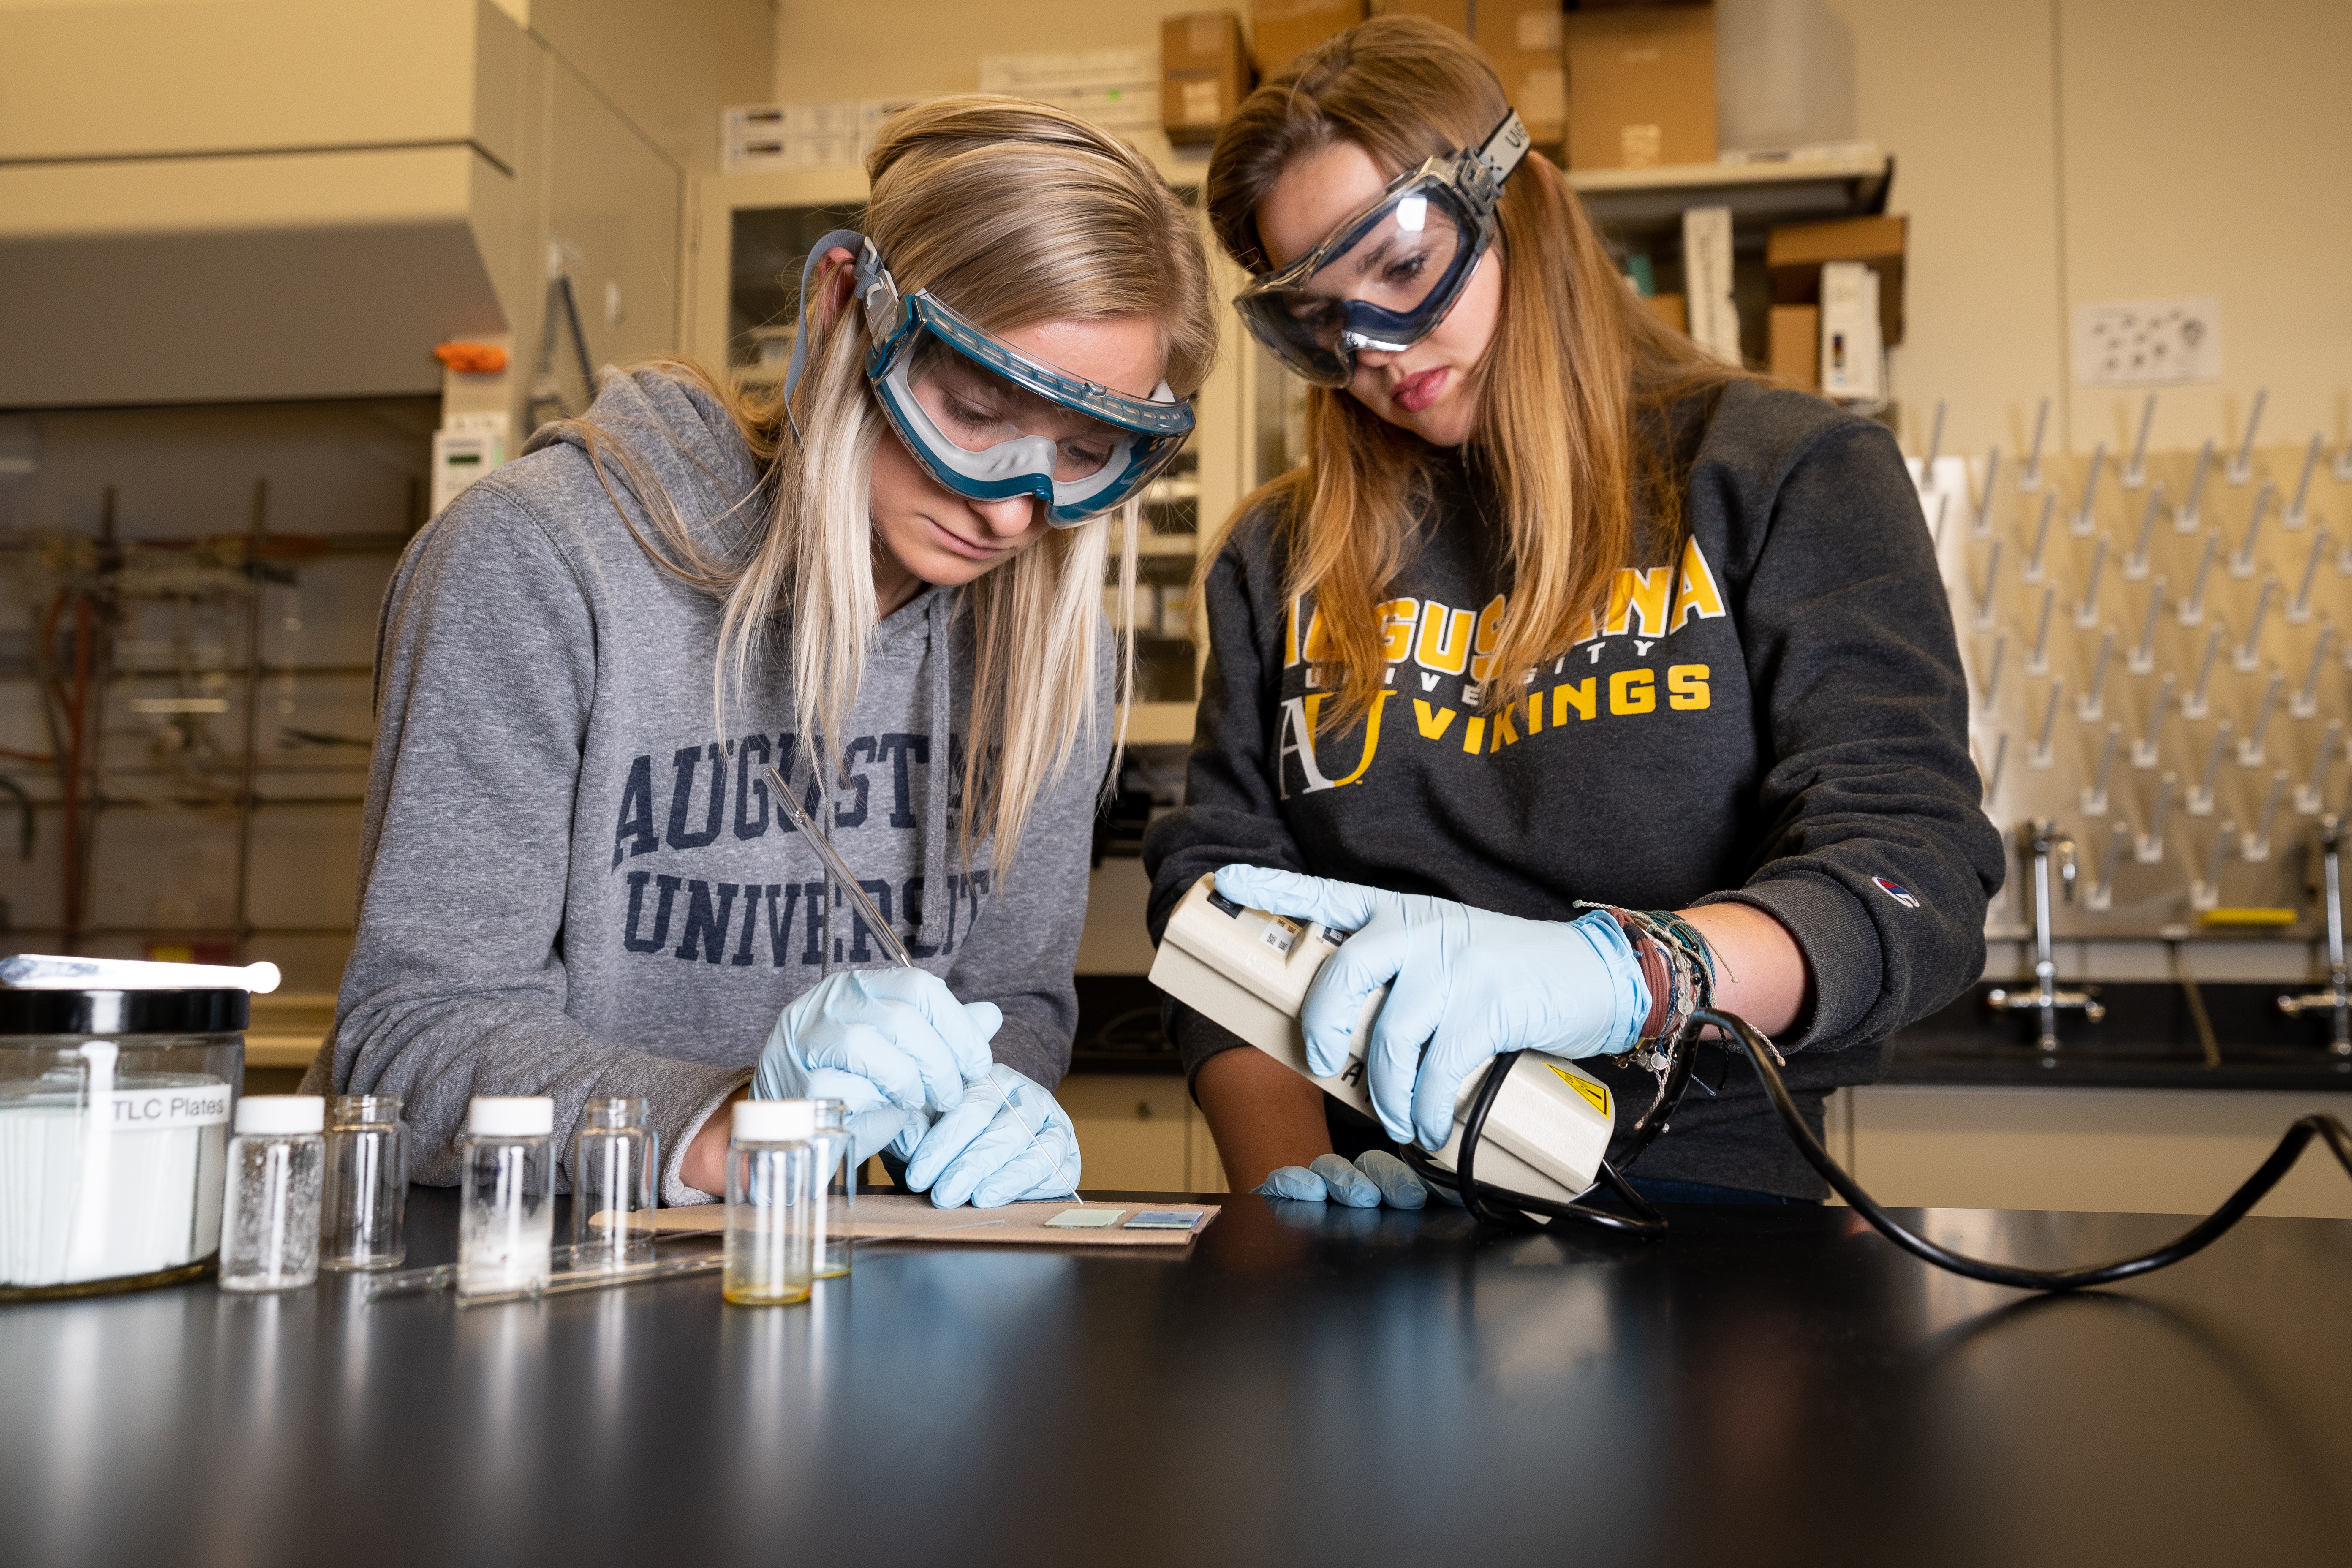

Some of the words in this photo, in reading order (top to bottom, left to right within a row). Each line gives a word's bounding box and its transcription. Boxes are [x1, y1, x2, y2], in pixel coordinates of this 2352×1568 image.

[1412, 663, 1710, 755] VIKINGS
[624, 869, 996, 967] UNIVERSIT
[112, 1098, 162, 1121] TLC
[171, 1097, 223, 1117] Plates
